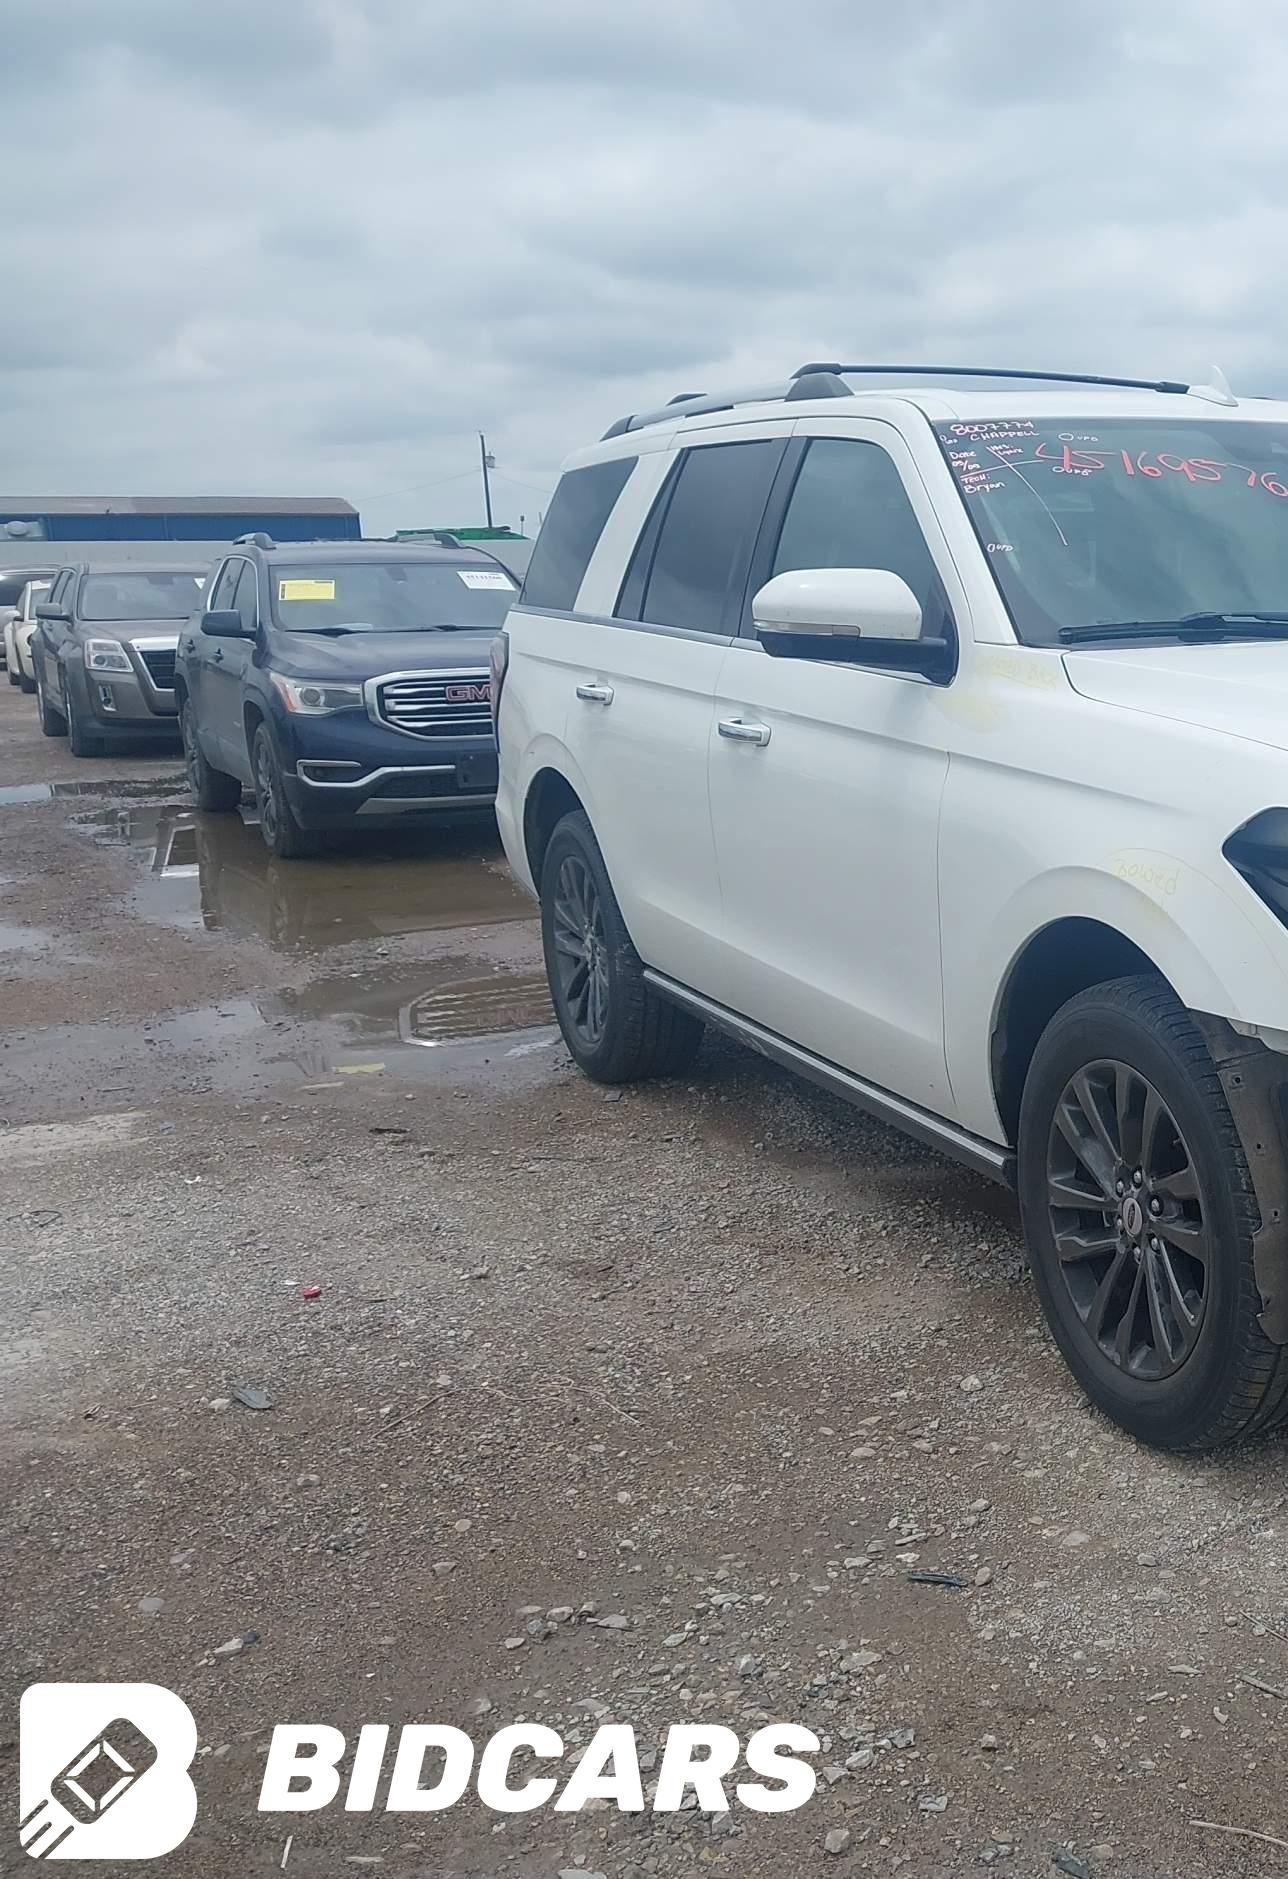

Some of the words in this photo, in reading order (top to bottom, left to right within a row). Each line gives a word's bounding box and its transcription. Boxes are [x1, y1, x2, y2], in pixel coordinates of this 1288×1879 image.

[970, 430, 1040, 441] CHAPPELL
[1035, 443, 1288, 496] 45169576
[964, 481, 1006, 494] Bryan
[445, 683, 491, 701] GM
